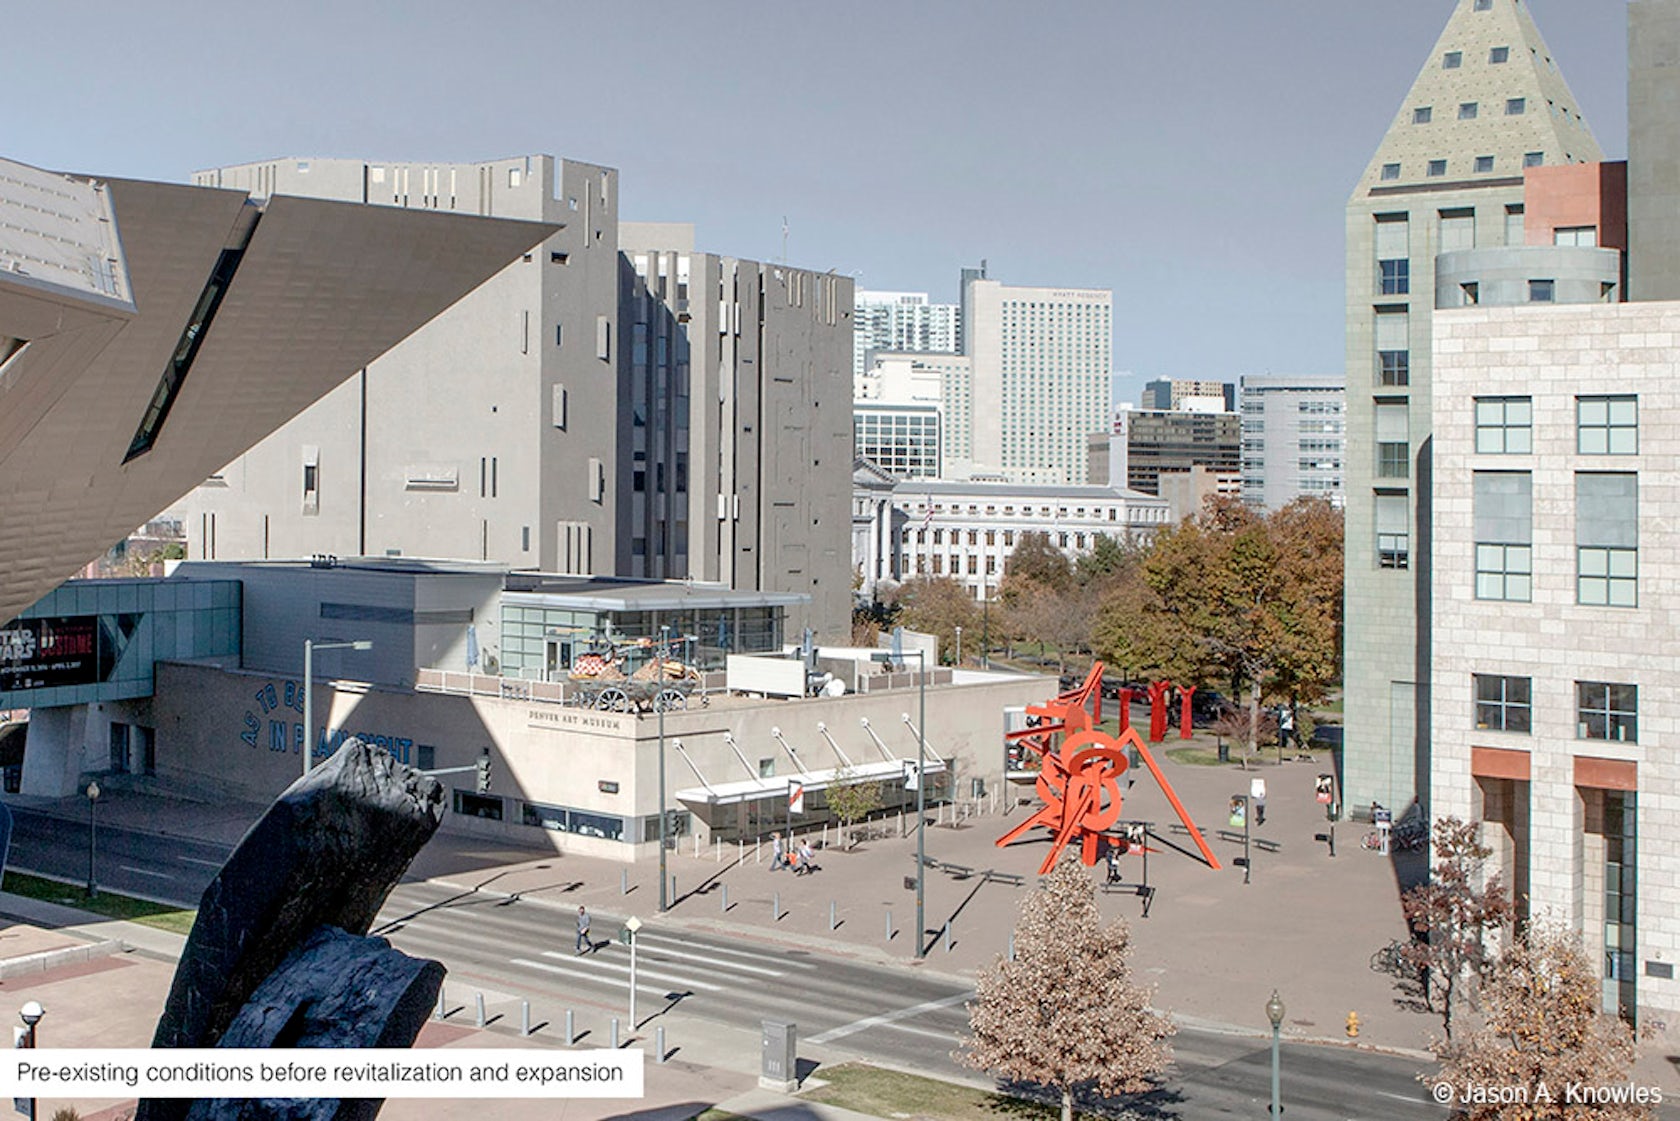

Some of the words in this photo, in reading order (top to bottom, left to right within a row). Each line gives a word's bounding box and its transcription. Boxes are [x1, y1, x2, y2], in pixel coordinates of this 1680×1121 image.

[0, 630, 36, 644] TAR
[241, 711, 260, 748] AS
[256, 683, 278, 714] TO
[529, 711, 559, 721] DENVER
[563, 715, 578, 724] ART
[582, 718, 620, 730] MUSEUM
[269, 720, 286, 752] IN
[293, 723, 349, 759] PAI
